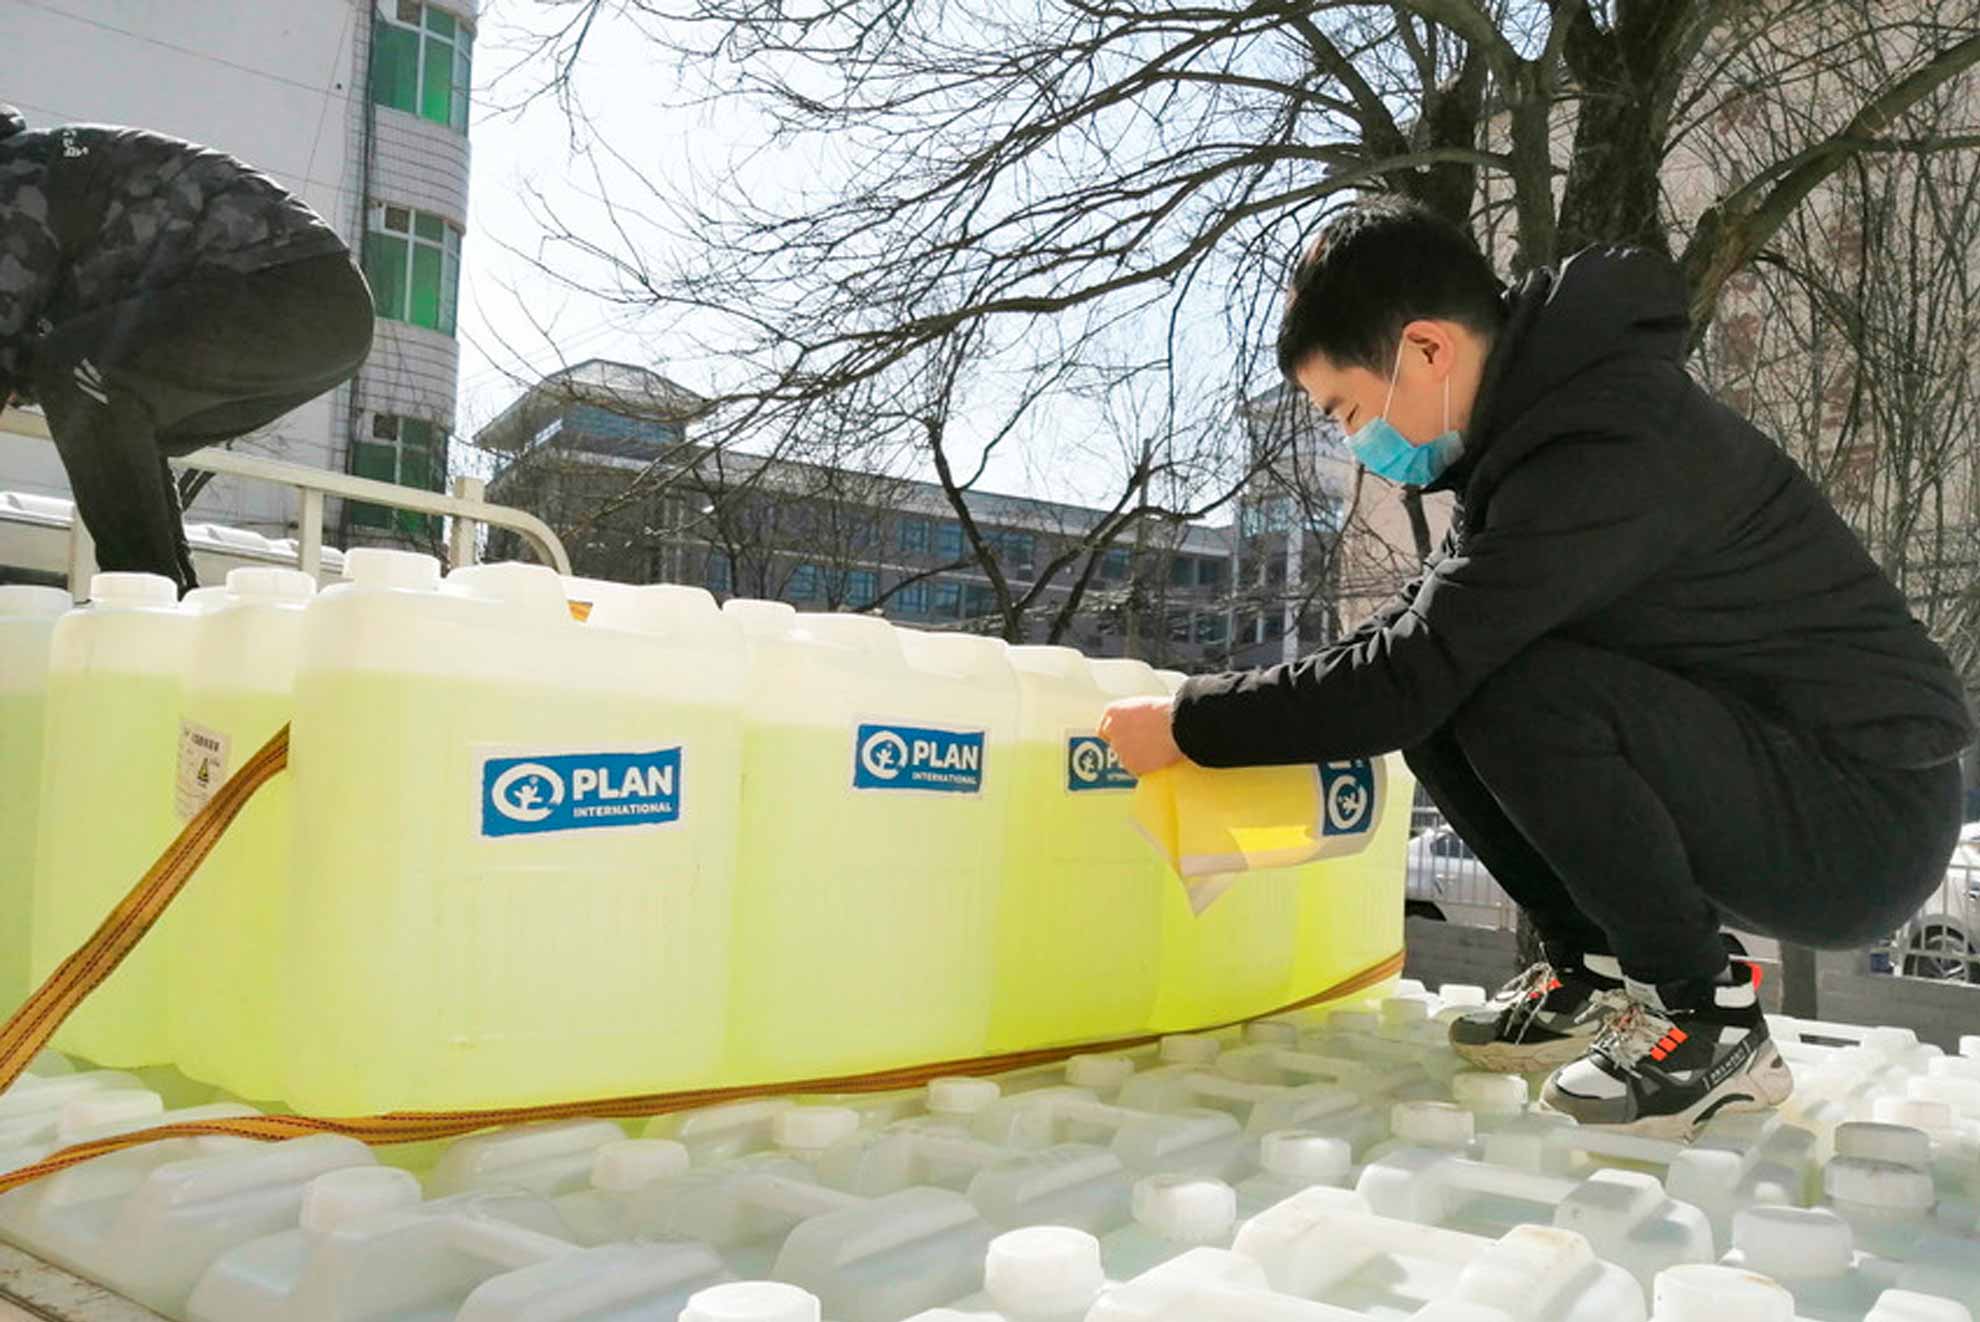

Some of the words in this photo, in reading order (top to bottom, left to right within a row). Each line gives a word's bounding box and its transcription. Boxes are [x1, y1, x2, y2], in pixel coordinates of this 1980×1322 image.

[913, 740, 978, 770] PLAN
[572, 765, 673, 801] PLAN
[574, 803, 672, 817] INTERNATIONAL
